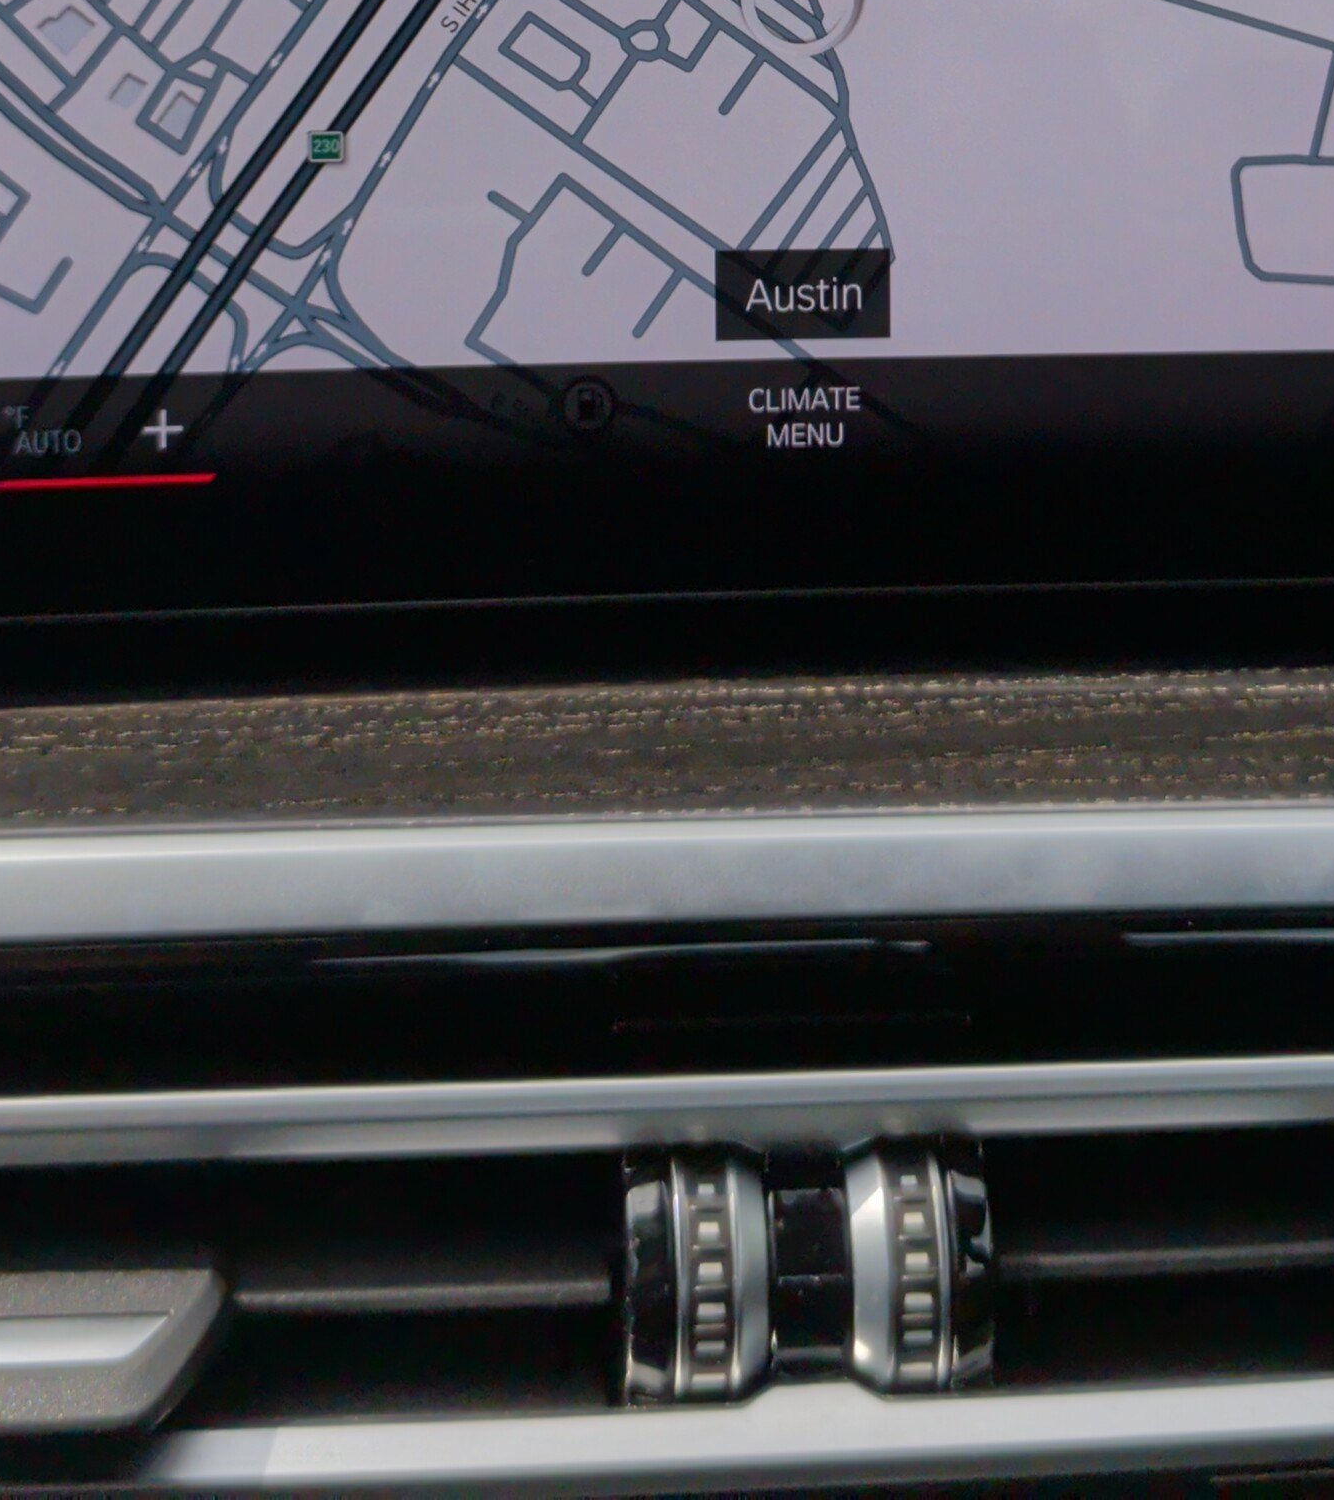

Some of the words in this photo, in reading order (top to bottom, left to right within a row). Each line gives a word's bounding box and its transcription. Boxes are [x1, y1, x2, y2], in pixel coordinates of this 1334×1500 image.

[441, 15, 459, 33] S
[313, 138, 340, 153] 230
[746, 276, 862, 313] Austin
[748, 387, 861, 413] CLIMATE
[14, 429, 82, 455] AUTO
[766, 422, 845, 448] MENU
